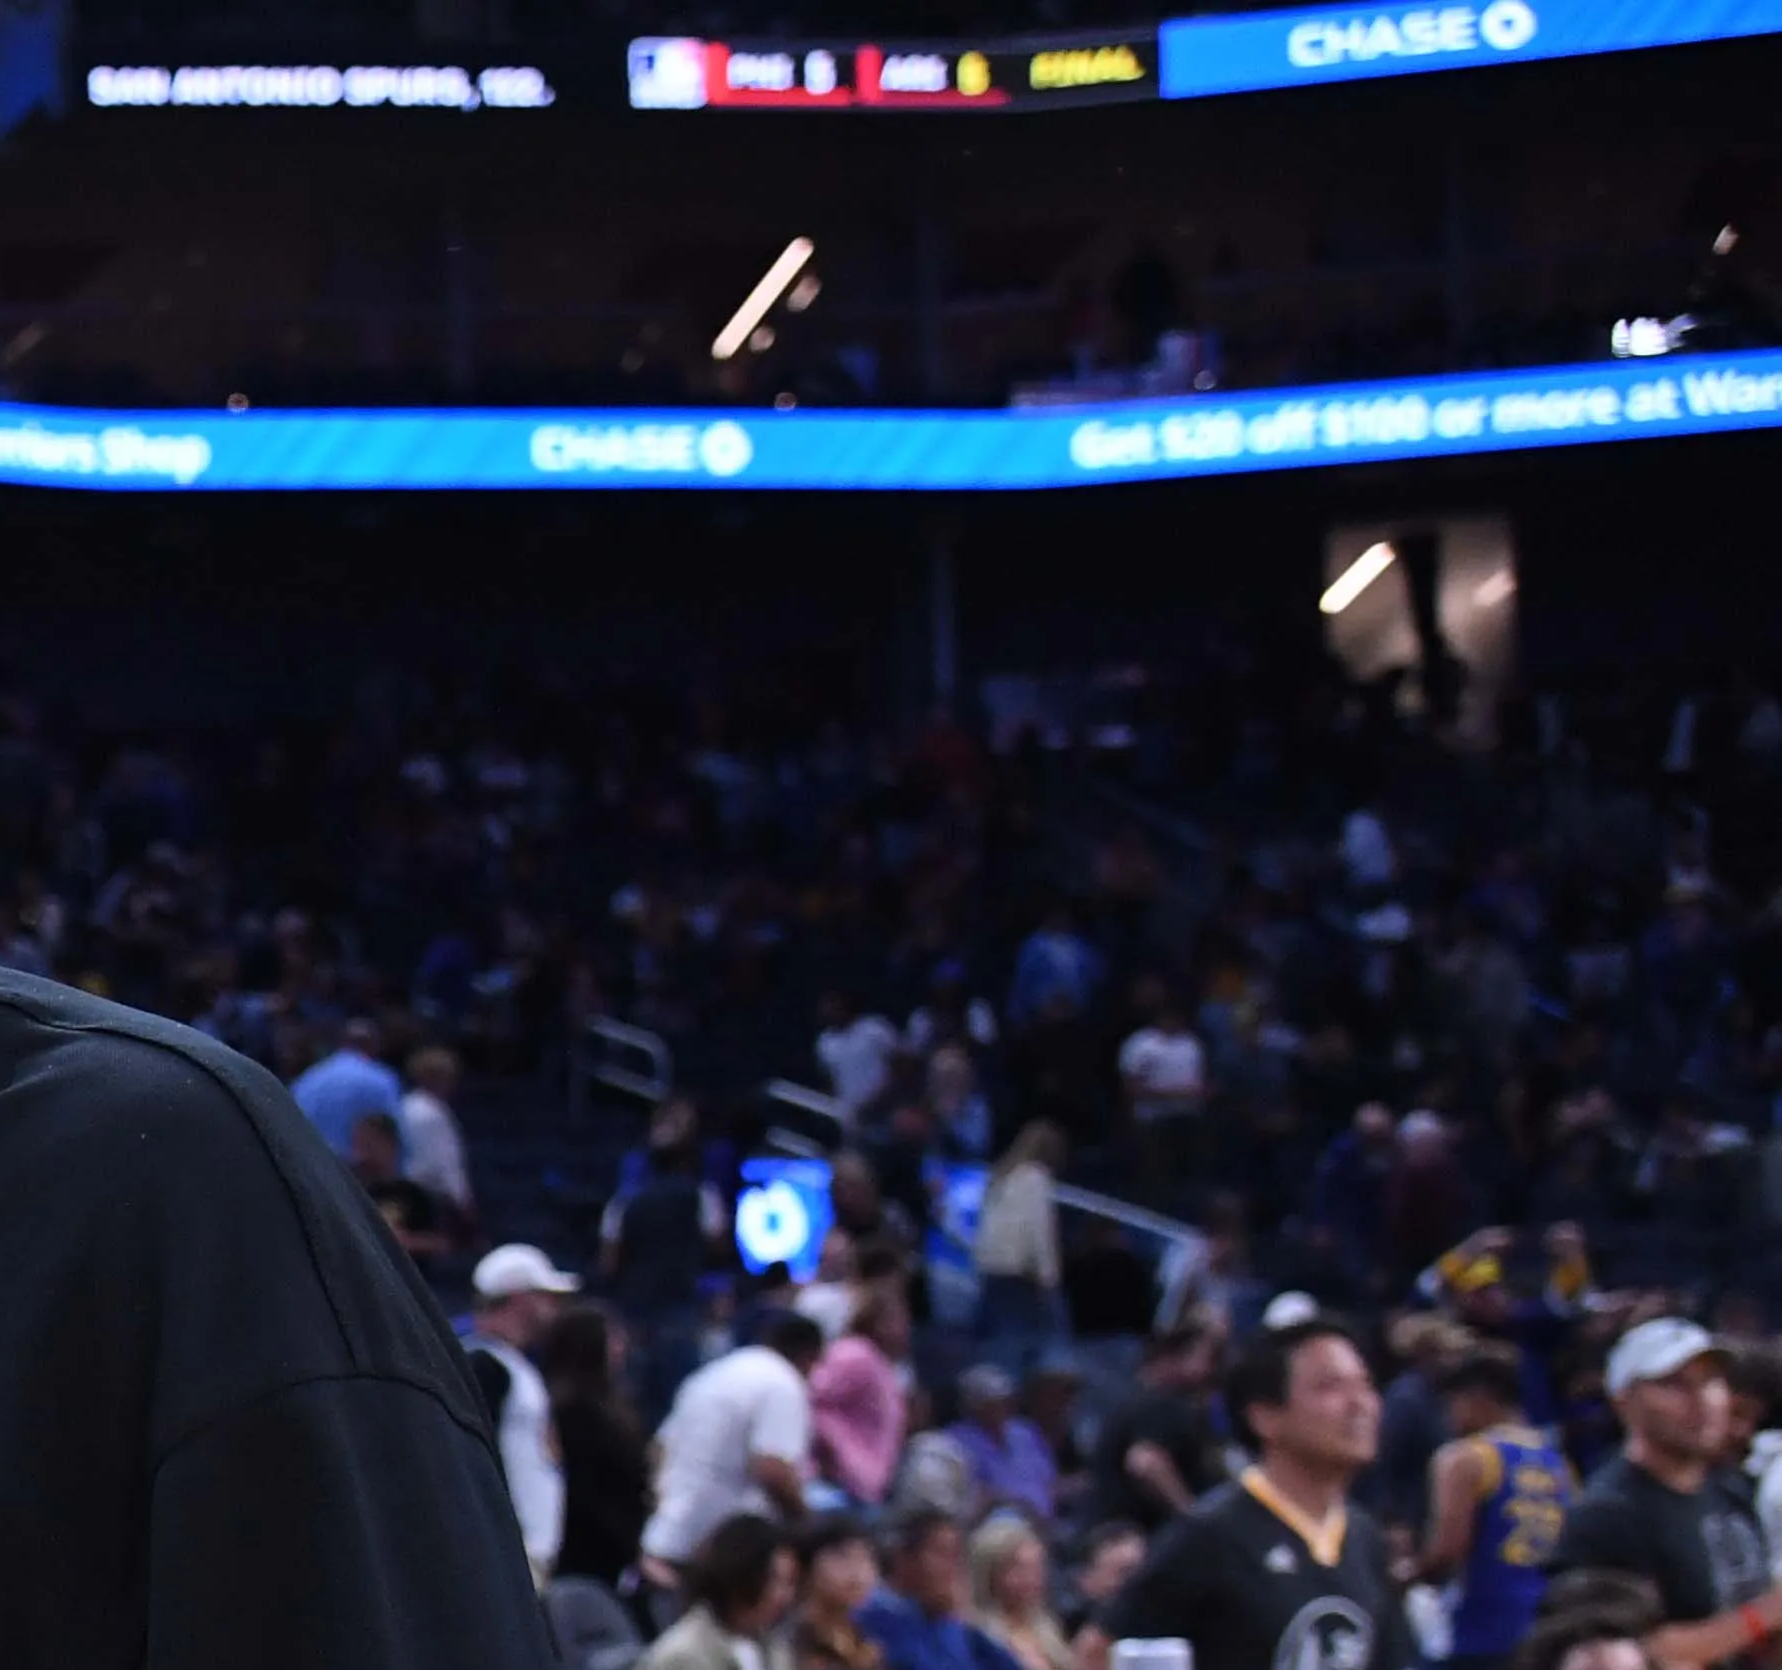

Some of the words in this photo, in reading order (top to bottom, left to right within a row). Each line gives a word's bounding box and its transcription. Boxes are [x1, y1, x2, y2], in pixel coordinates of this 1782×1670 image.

[1288, 6, 1476, 67] CHASE
[1030, 46, 1144, 90] FINAL
[531, 424, 697, 471] CHASE
[1070, 419, 1154, 469] Get
[1159, 411, 1244, 460] $20
[1245, 404, 1318, 454] off
[1319, 394, 1428, 446] $100
[1433, 398, 1487, 439] or
[1492, 386, 1622, 433] more
[1625, 378, 1682, 421] at
[96, 425, 211, 484] Shop
